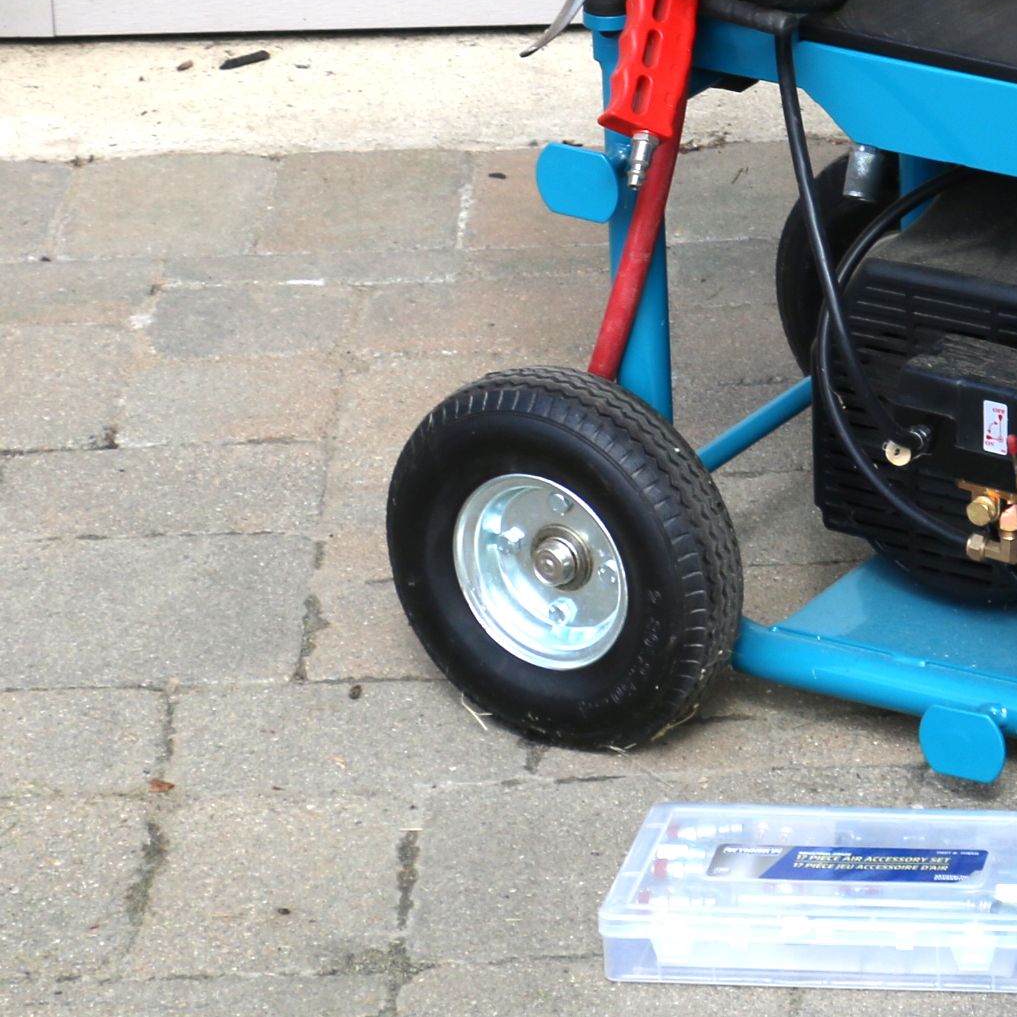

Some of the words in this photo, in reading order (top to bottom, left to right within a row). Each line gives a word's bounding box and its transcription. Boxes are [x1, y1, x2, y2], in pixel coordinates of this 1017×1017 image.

[809, 854, 841, 862] PIECE
[864, 855, 928, 863] ACCESSORY
[855, 863, 918, 871] ACCESSOIRE
